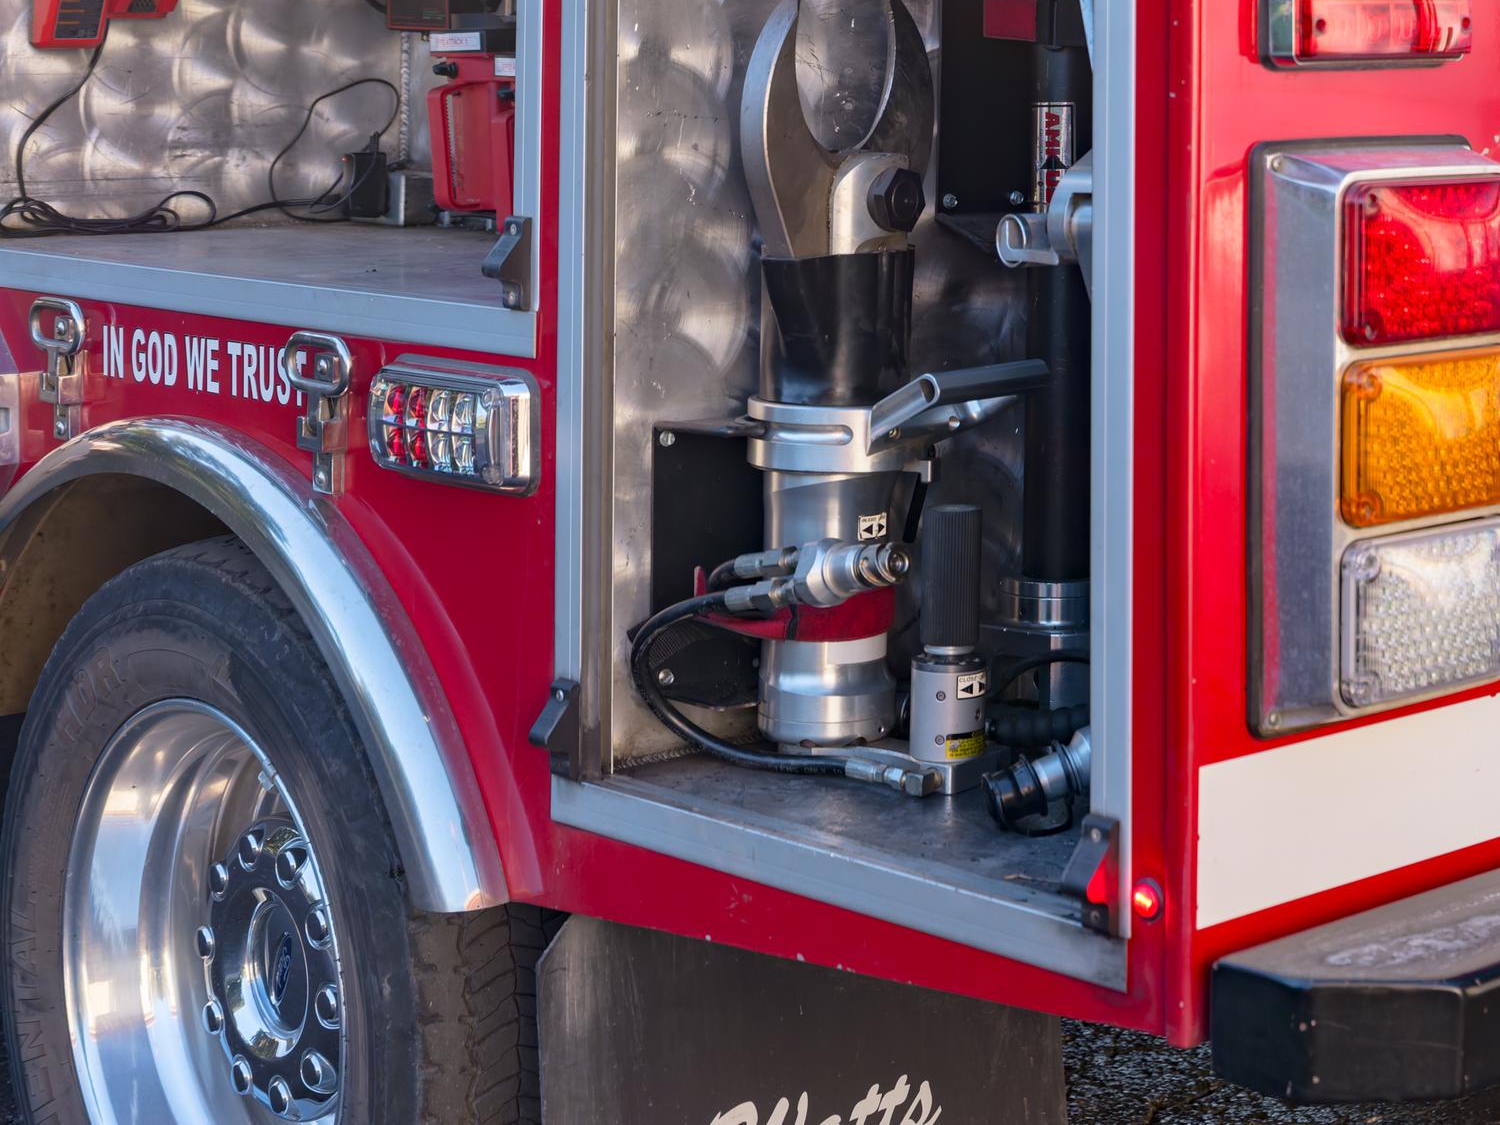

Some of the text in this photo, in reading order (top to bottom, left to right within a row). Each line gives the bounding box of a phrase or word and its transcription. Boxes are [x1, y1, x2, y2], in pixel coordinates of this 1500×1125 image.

[103, 324, 124, 379] IN
[131, 328, 178, 387] GOD
[184, 335, 220, 394] WE
[10, 902, 59, 1125] ENTAL
